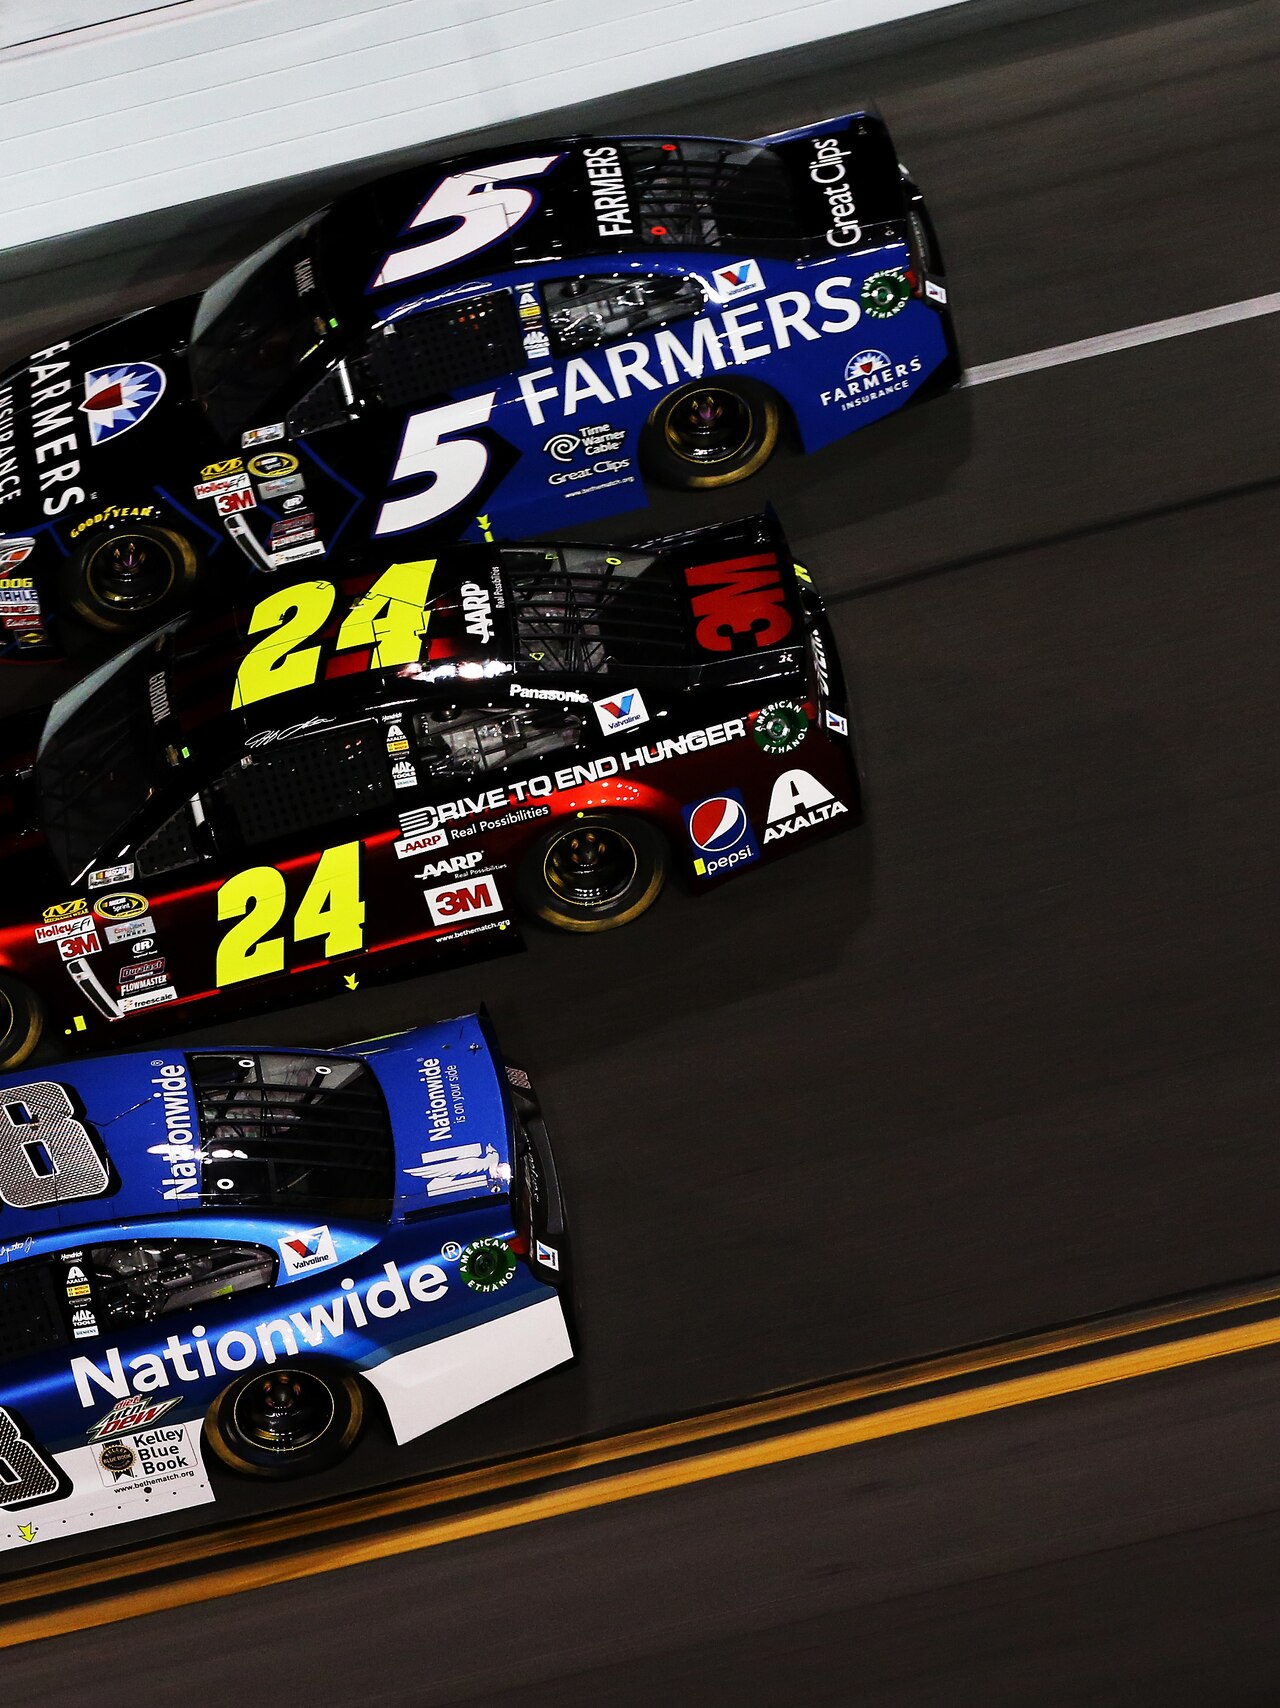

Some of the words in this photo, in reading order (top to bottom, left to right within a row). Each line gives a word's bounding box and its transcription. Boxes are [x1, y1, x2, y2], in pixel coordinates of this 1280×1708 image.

[809, 138, 852, 184] Clips
[583, 146, 634, 237] FARMERS
[370, 154, 565, 291] 5
[825, 183, 862, 248] Great
[864, 295, 909, 319] ETHANOL
[517, 276, 861, 426] FARMERS
[820, 358, 922, 406] FARMERS
[841, 379, 910, 412] INSURANCE
[29, 341, 86, 516] FARMERS
[579, 424, 610, 437] Time
[581, 430, 626, 446] Warner
[585, 441, 620, 456] Cable
[373, 391, 497, 536] 5
[548, 466, 593, 485] Great
[593, 459, 631, 473] Clips
[219, 490, 254, 513] 3M
[70, 505, 152, 538] GOODYEAR
[461, 582, 494, 644] AARP
[684, 552, 792, 652] 3M
[231, 559, 437, 711] 24
[149, 671, 170, 722] GORDON
[509, 684, 589, 704] Panasonic
[608, 713, 641, 730] Valvoline
[754, 700, 802, 733] AMERICAN
[762, 726, 808, 754] ETHANOL
[398, 788, 509, 838] DRIVE
[508, 775, 553, 801] TO
[555, 755, 620, 790] END
[621, 719, 746, 773] HUNGER
[401, 835, 442, 853] AARP
[450, 824, 477, 840] Real
[479, 806, 550, 832] Possibilities
[763, 800, 848, 844] AXALTA
[414, 851, 485, 880] AARP
[455, 871, 469, 879] Real
[470, 864, 508, 875] Possibilities
[706, 845, 753, 876] pepsi
[72, 909, 89, 917] WEAR
[113, 903, 131, 912] Sprint
[435, 884, 494, 916] 3M
[216, 840, 365, 988] 24
[37, 925, 72, 940] Holley
[71, 918, 91, 932] EFI
[435, 919, 510, 943] www.bethematch.org
[61, 933, 99, 958] 3M
[121, 975, 167, 996] FLOWMASTER
[134, 993, 173, 1008] freescale
[444, 1065, 459, 1082] side
[449, 1083, 465, 1102] your
[453, 1103, 465, 1115] on
[453, 1115, 466, 1124] is
[292, 1252, 331, 1270] Valvoline
[459, 1238, 509, 1273] AMERICAN
[467, 1264, 517, 1293] ETHANOL
[133, 1428, 184, 1447] Kelley
[138, 1445, 180, 1461] Blue
[142, 1456, 189, 1475] Book
[114, 1471, 195, 1493] www.bethematch.org
